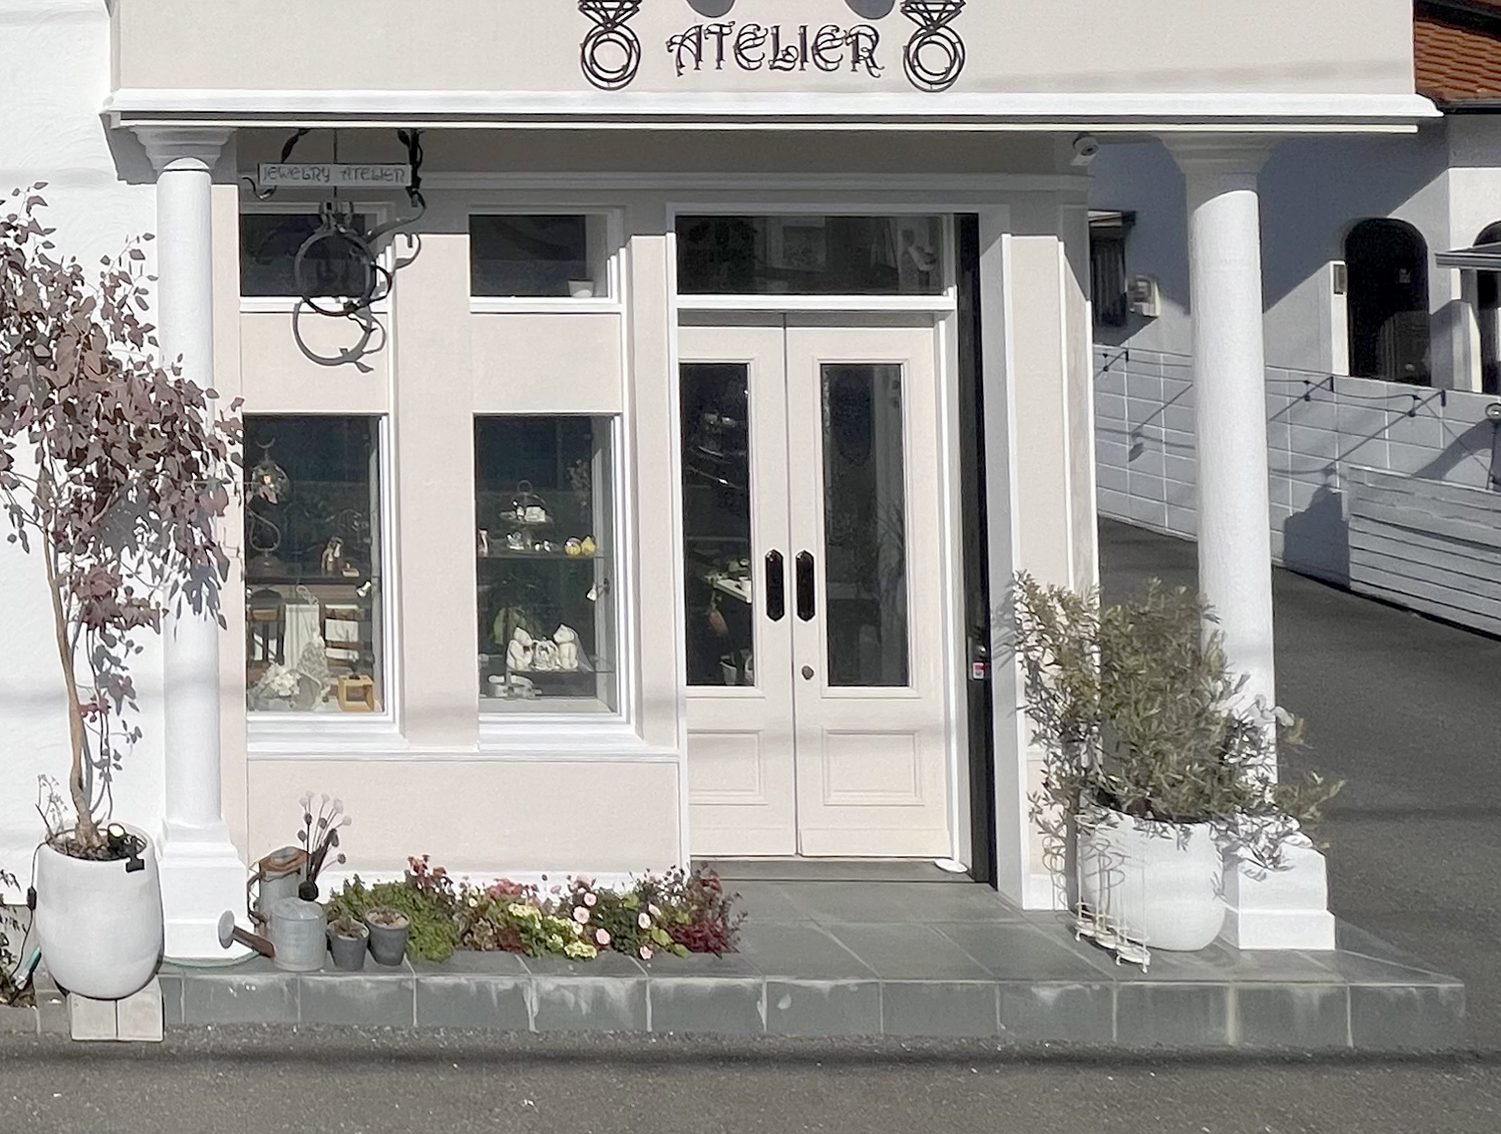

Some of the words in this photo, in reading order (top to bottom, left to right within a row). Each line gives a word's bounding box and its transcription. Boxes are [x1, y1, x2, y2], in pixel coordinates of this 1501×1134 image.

[665, 21, 885, 78] ATELIER
[263, 166, 330, 183] JEWELRY
[340, 167, 405, 183] ATELIER
